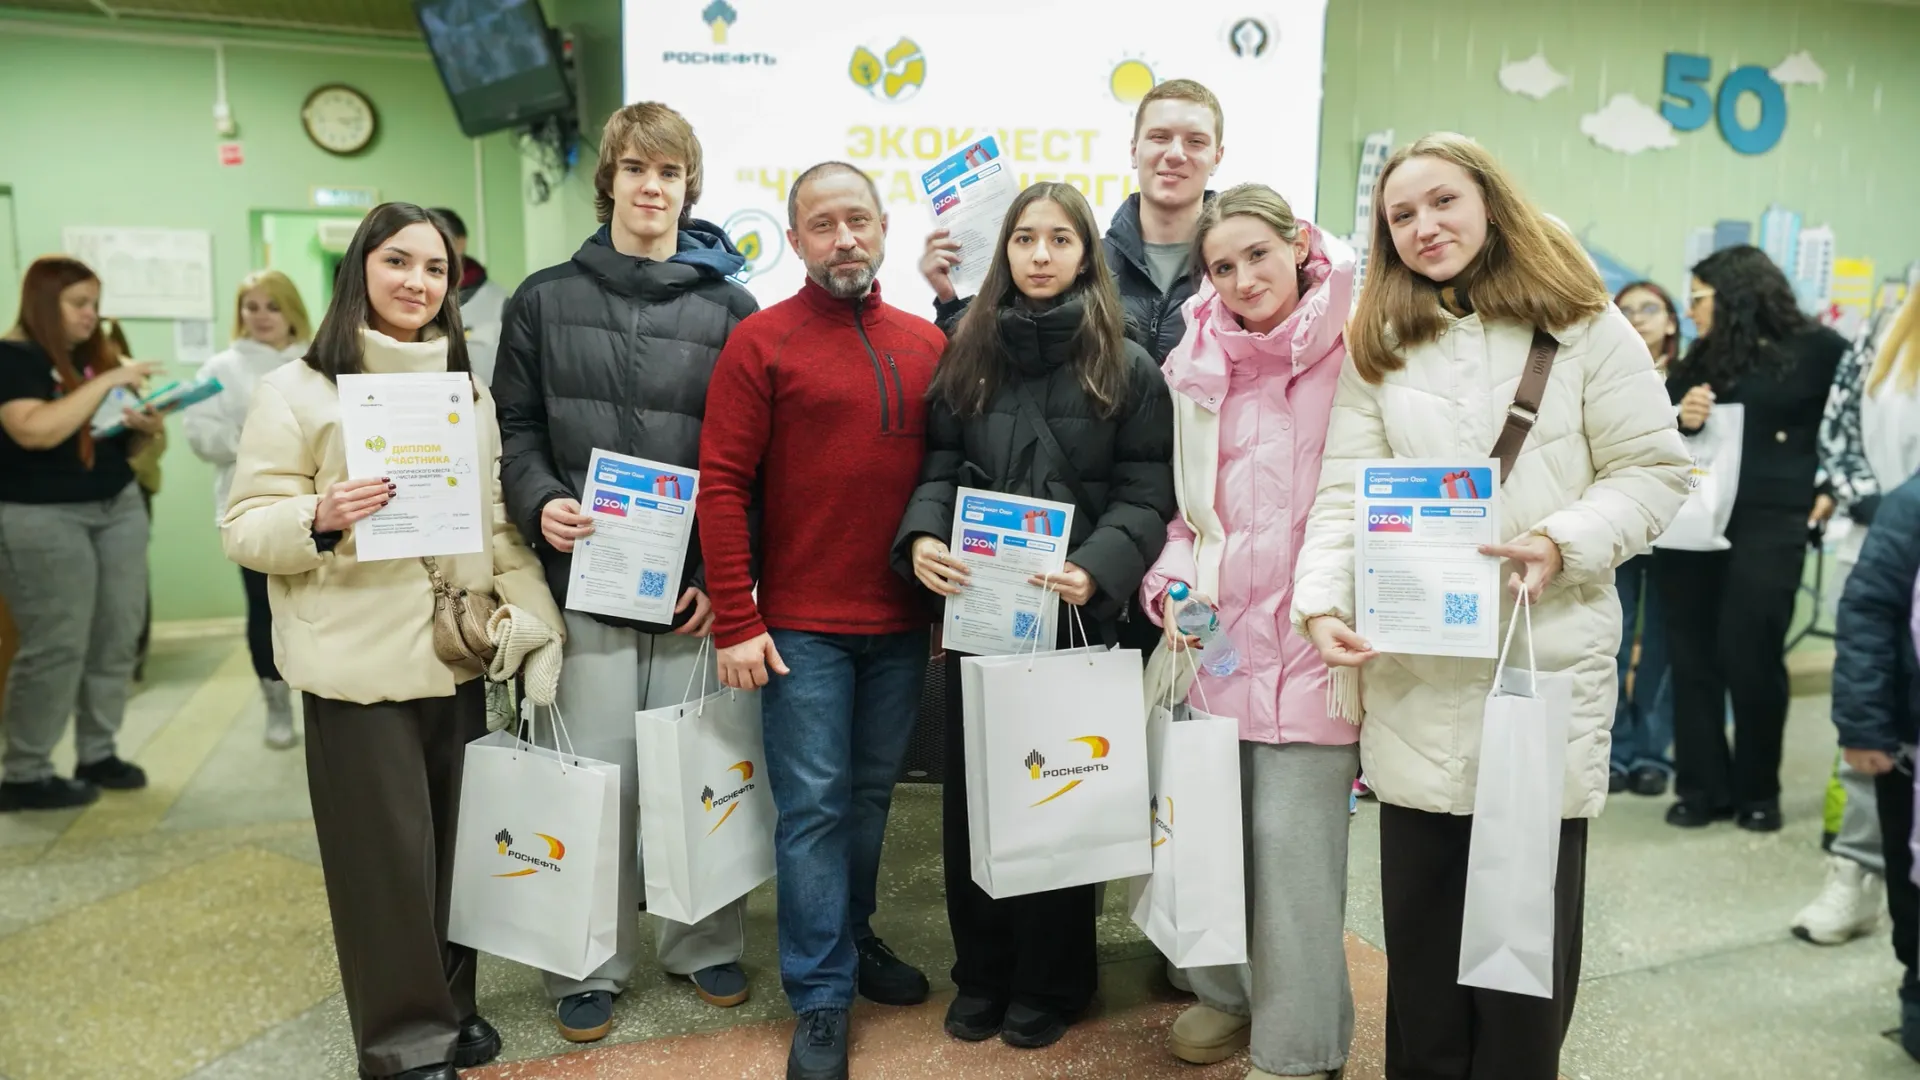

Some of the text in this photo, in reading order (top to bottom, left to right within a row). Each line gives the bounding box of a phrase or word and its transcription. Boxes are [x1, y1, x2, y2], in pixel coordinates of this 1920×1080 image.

[662, 50, 777, 65] РОСНЕФТЬ
[1661, 52, 1787, 155] 50
[934, 191, 958, 211] OZON
[392, 444, 441, 455] ДИПЛОМ
[385, 456, 450, 465] УЧАСТНИКА
[594, 497, 630, 511] OZON
[1369, 514, 1412, 525] OZON
[963, 536, 997, 550] OZON
[1043, 763, 1109, 779] РОСНЕФТЬ
[712, 783, 755, 808] РОСНЕФТЬ
[508, 849, 561, 873] РОСНЕФТЬ
